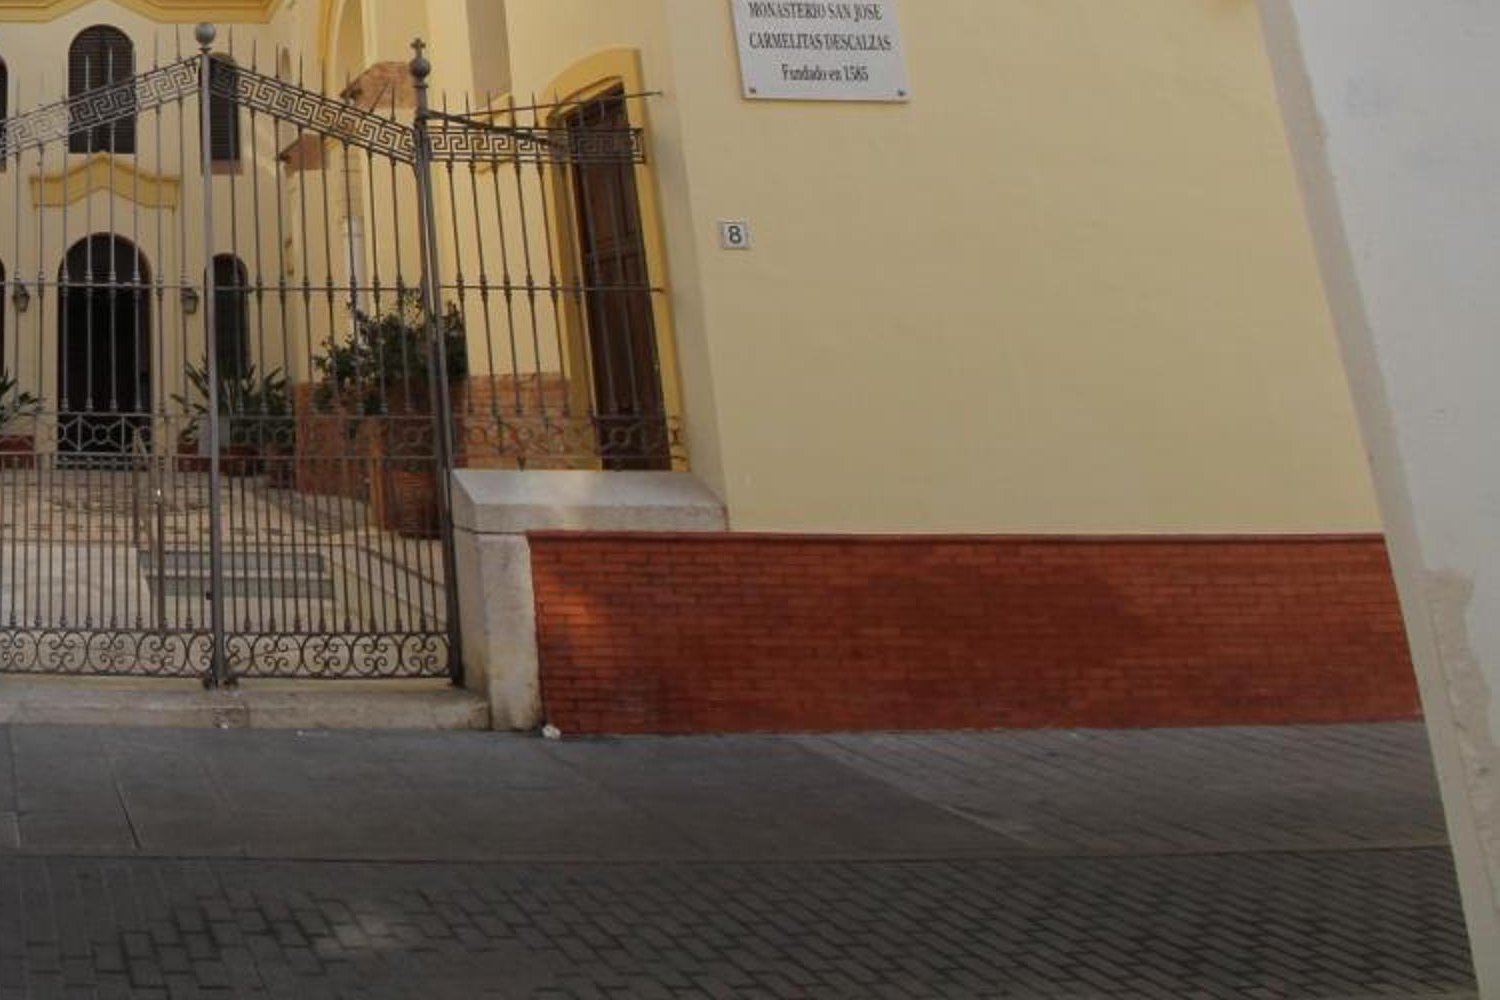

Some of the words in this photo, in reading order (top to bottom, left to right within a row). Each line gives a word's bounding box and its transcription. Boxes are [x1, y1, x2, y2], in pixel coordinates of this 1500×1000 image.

[748, 2, 826, 19] MONASTERIO
[828, 3, 851, 20] SAN
[749, 32, 823, 50] CARMELITAS
[824, 33, 892, 51] DESCALZAS
[781, 63, 827, 81] Fundado
[828, 69, 842, 81] en
[728, 225, 742, 244] 8
